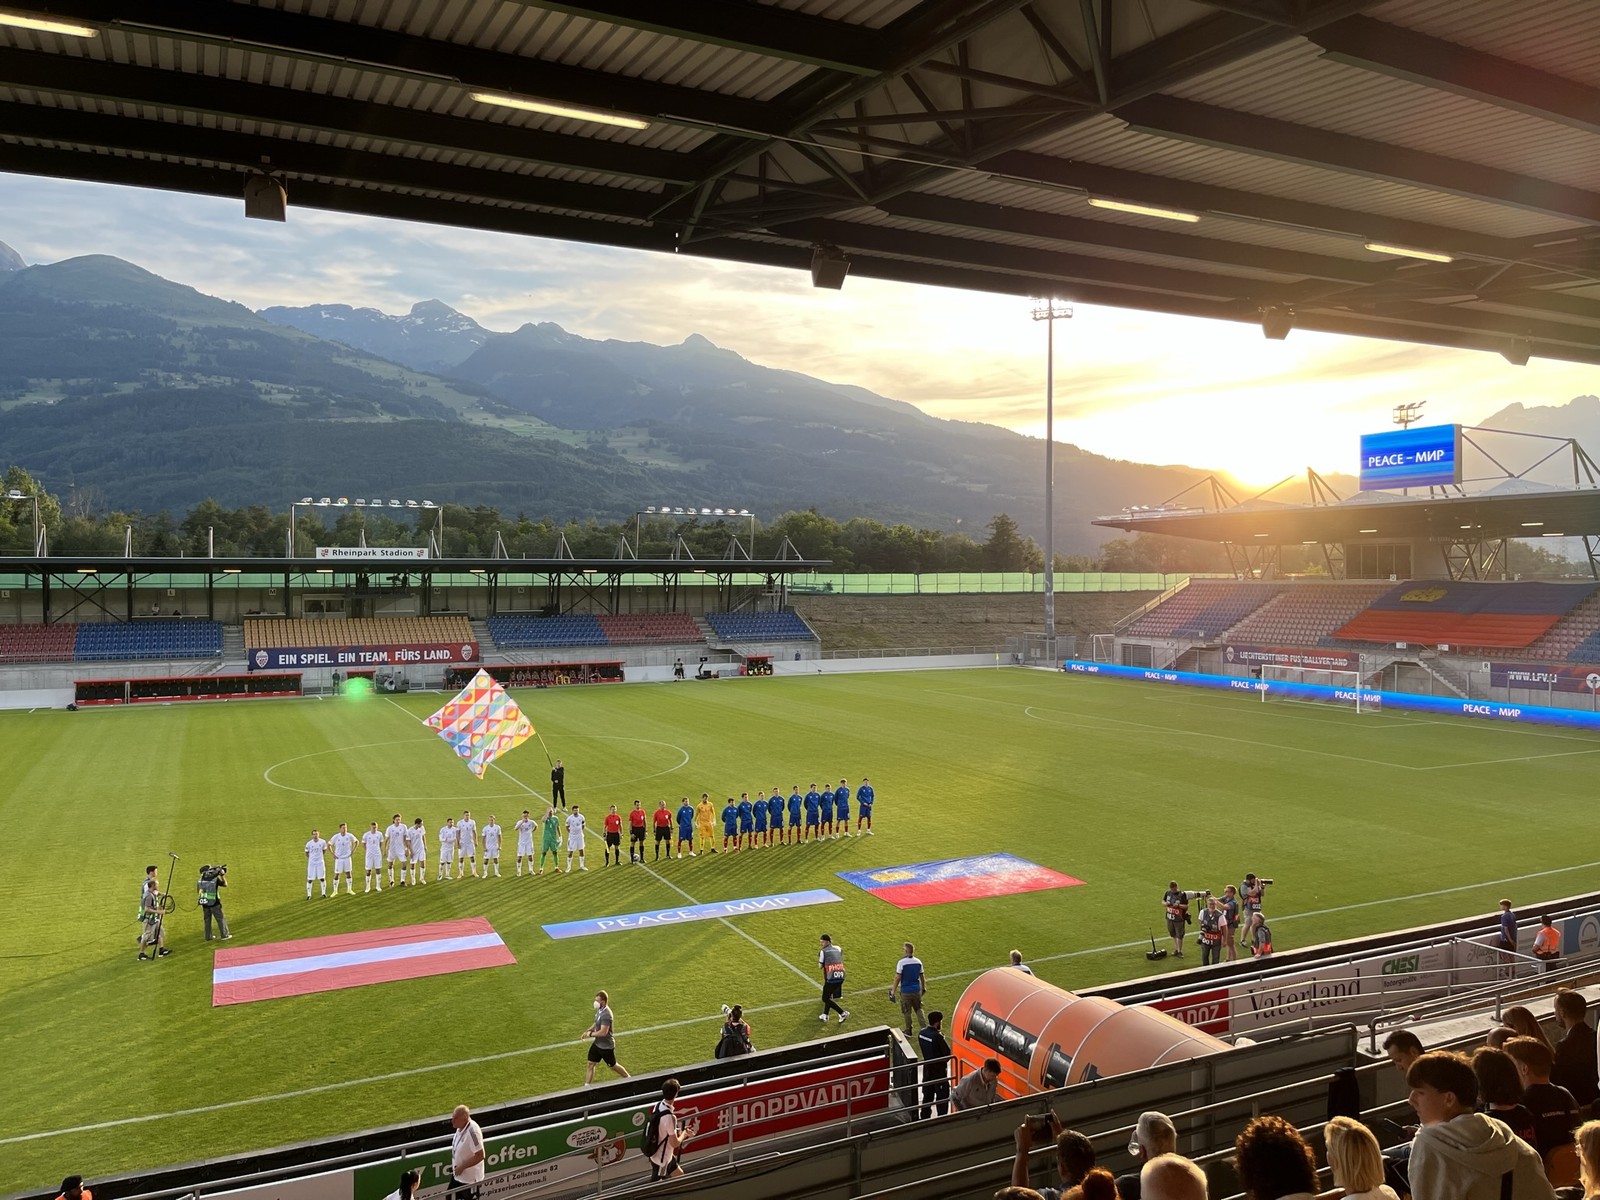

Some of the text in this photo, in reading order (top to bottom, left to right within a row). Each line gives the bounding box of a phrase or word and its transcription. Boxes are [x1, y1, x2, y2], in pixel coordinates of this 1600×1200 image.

[1368, 454, 1404, 467] PEACE
[1415, 450, 1444, 463] МИР
[332, 549, 414, 557] Rheinpark Stadion
[278, 648, 453, 665] EIN SPIEL. EIN TEAM. FÜRS LAND.
[1071, 663, 1085, 672] PEACE
[1144, 671, 1160, 679] PEACE
[1231, 680, 1250, 689] PEACE
[1334, 690, 1357, 700] PEACE
[1463, 704, 1490, 714] PEACE
[1499, 707, 1521, 718] МИР
[596, 908, 698, 930] PEACE
[723, 897, 791, 913] МИР
[1381, 954, 1420, 975] CHESI
[1247, 967, 1361, 1021] Vaterland
[571, 1128, 602, 1142] PIZZERIA
[576, 1134, 600, 1147] TOSCANA
[487, 1143, 538, 1166] offen
[512, 1167, 548, 1180] Zollstrasse
[549, 1164, 558, 1172] 82
